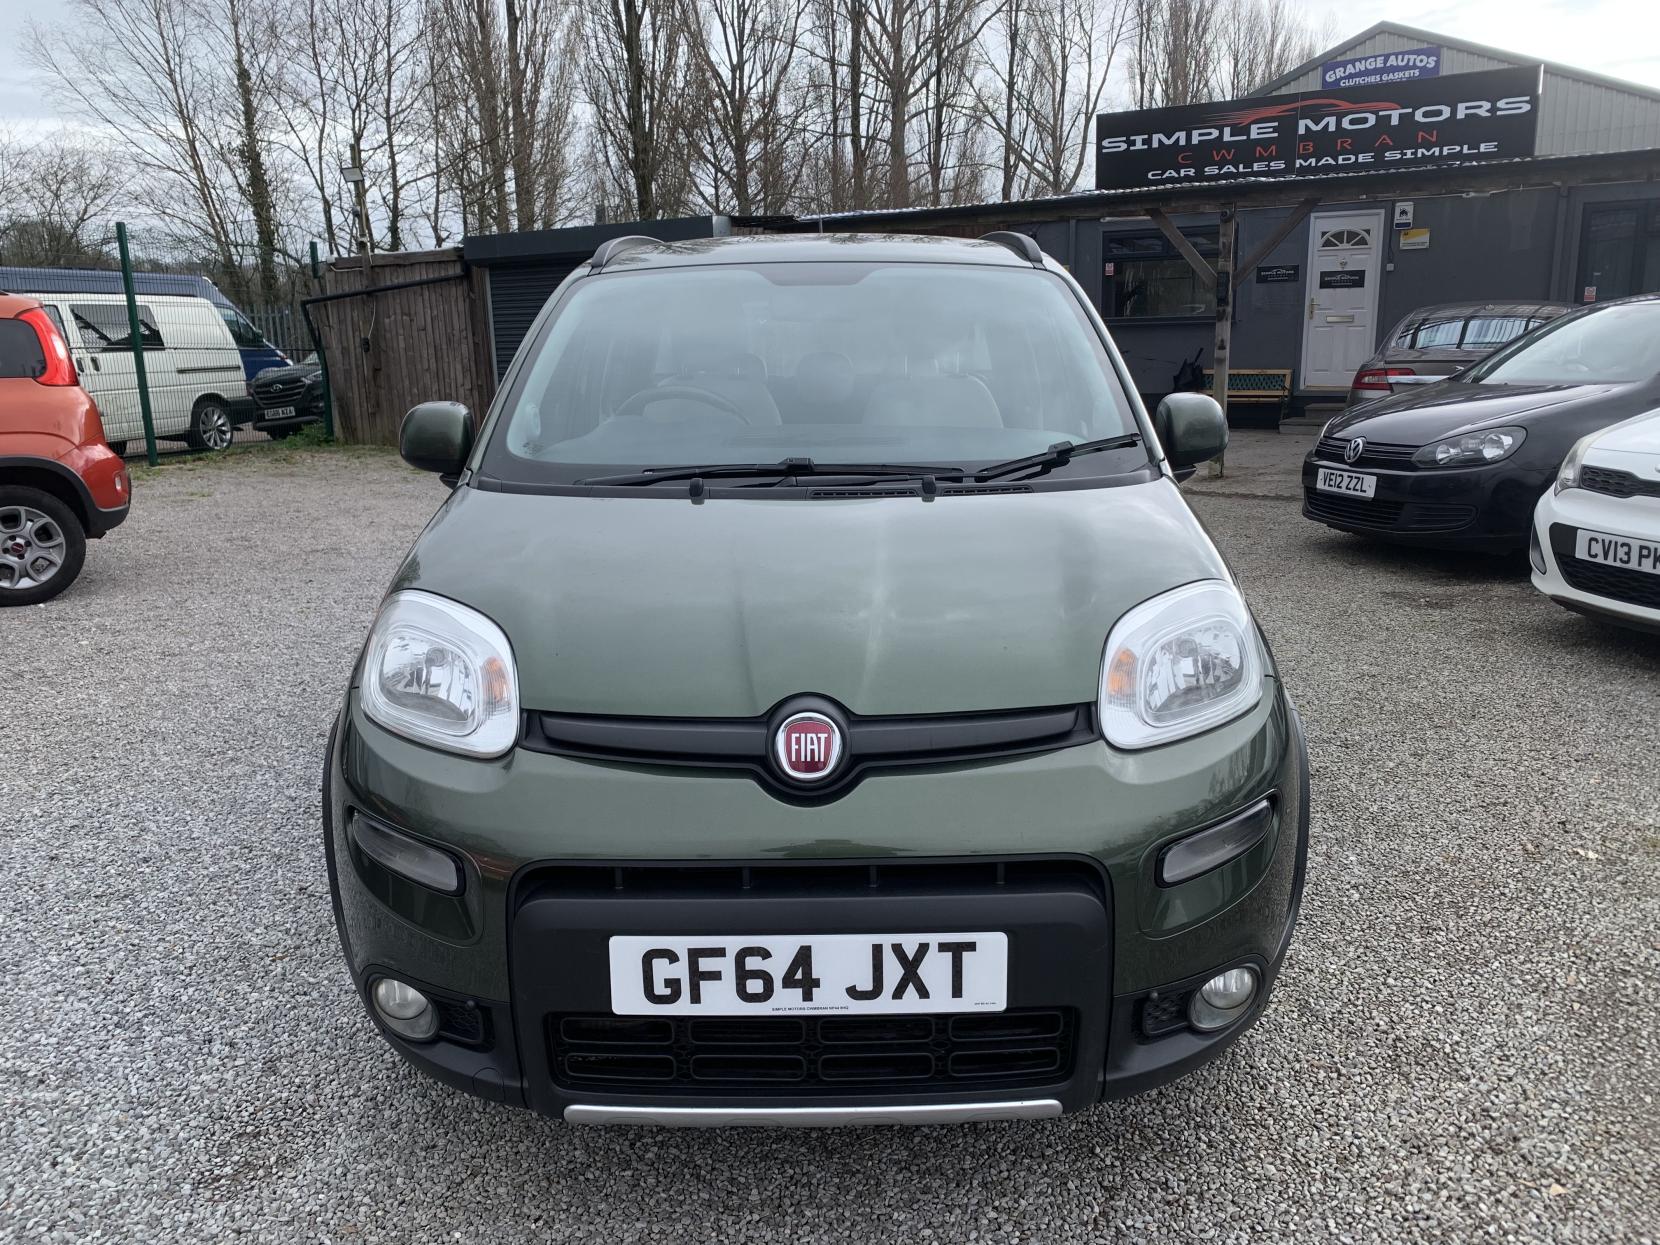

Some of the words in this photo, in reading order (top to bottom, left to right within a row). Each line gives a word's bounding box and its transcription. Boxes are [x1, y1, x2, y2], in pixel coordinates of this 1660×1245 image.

[1325, 56, 1384, 83] GRANGE
[1386, 54, 1438, 69] AUTOS
[1340, 74, 1380, 87] CLUTCHES
[1381, 69, 1420, 81] GASKETS
[1102, 121, 1279, 153] SIMPLE
[1298, 96, 1531, 135] MOTORS
[1147, 168, 1196, 180] CAR
[1204, 160, 1286, 176] SALES
[1296, 152, 1375, 168] MADE
[1384, 142, 1499, 161] SIMPLE
[1323, 471, 1344, 489] VE12
[1345, 475, 1367, 493] ZZL
[1588, 536, 1632, 565] CV13
[791, 733, 828, 762] FIAT
[641, 944, 821, 1005] GF64
[845, 941, 977, 1001] JXT
